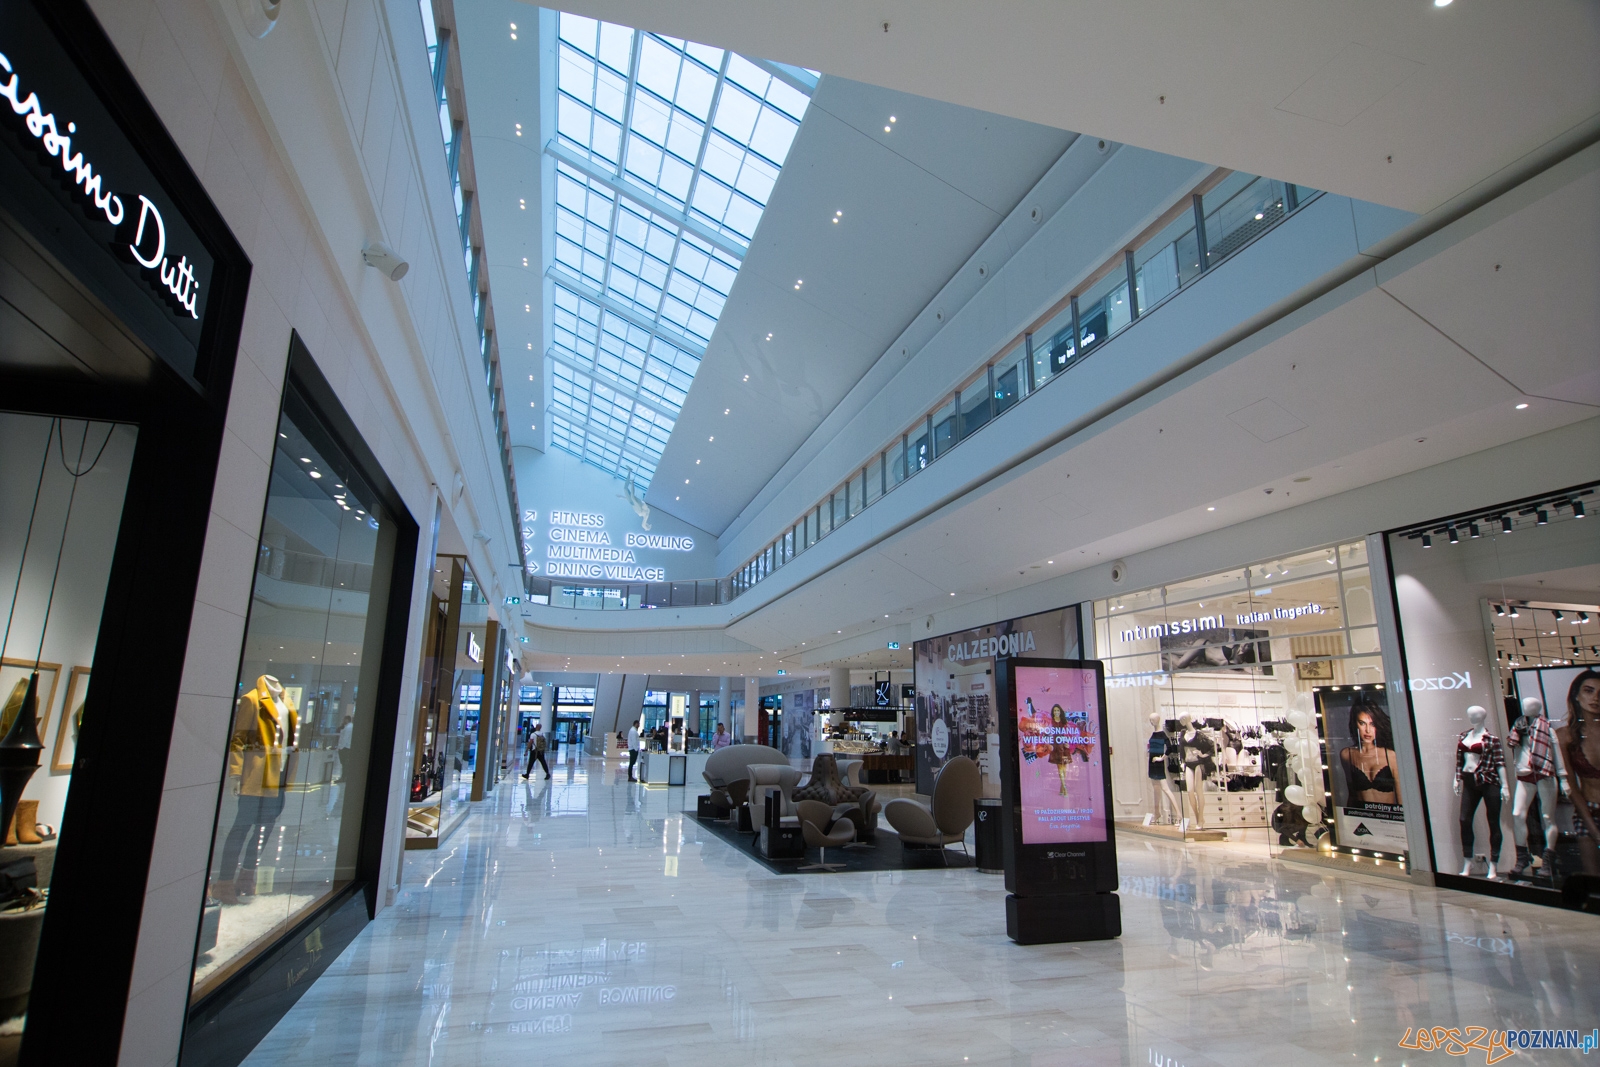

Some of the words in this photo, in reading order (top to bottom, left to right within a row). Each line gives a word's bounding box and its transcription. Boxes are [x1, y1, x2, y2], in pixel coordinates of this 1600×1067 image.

[129, 194, 199, 320] Dutti
[551, 511, 604, 527] FITNESS
[550, 528, 610, 545] CINEMA
[627, 533, 694, 550] BOWLING
[548, 545, 636, 562] MULTIMEDIA
[547, 562, 602, 577] DINING
[606, 565, 665, 581] VILLAGE
[1236, 611, 1272, 625] Italian
[947, 630, 1037, 662] CALZEDONIA
[1039, 726, 1079, 735] POSNANIA
[1023, 736, 1054, 744] WIELKIE
[1055, 736, 1096, 744] OTWARCIE
